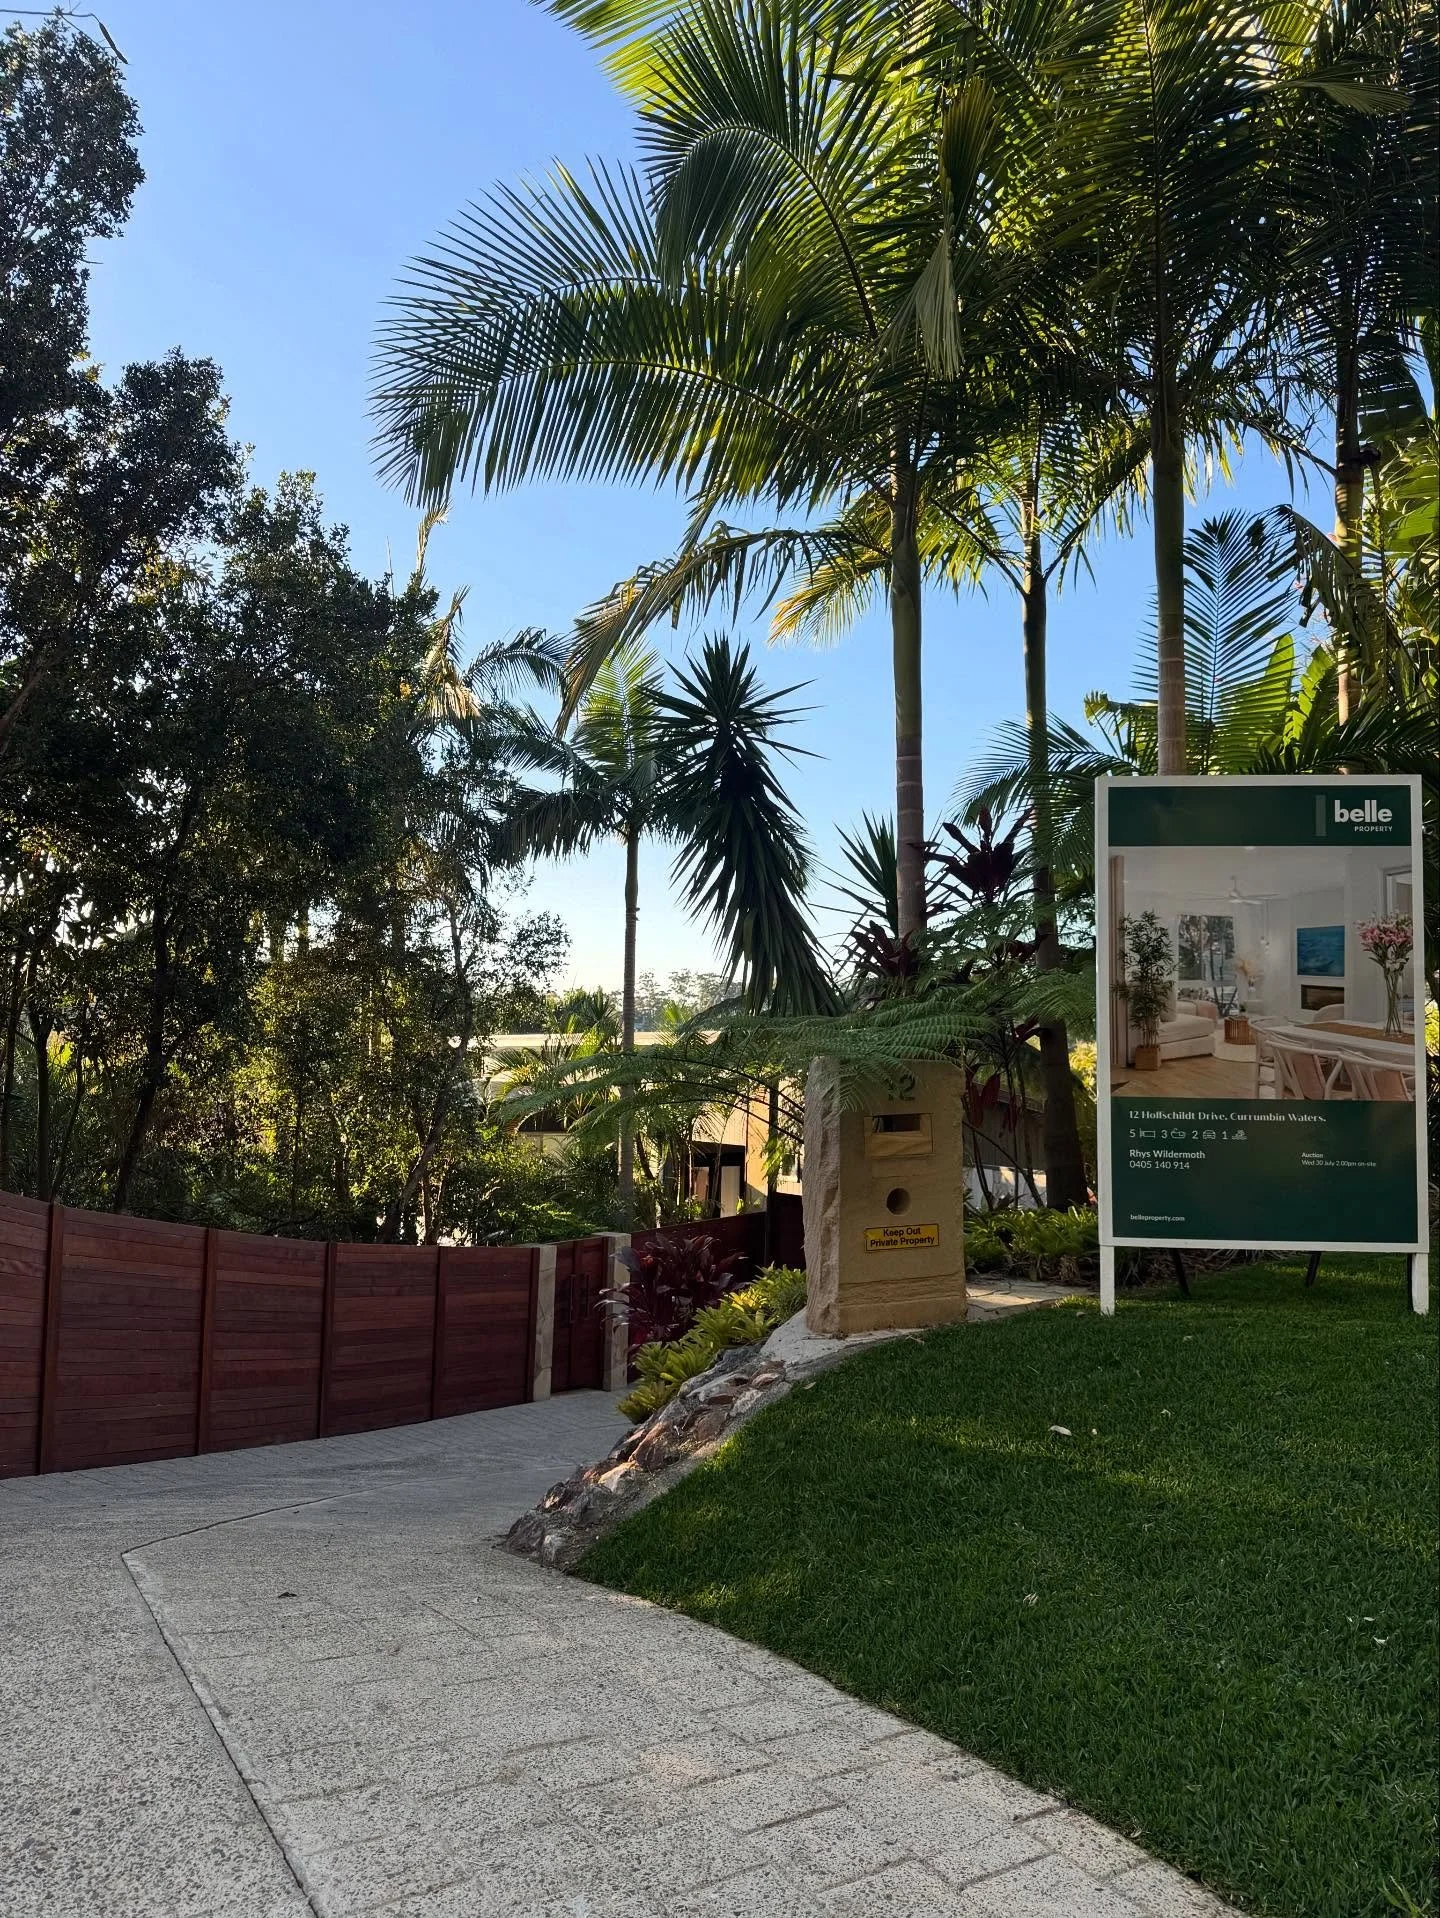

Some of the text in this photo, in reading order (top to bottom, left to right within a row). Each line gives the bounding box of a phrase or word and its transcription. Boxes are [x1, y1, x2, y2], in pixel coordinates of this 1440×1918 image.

[1334, 799, 1393, 823] belle
[1129, 1110, 1139, 1119] 12
[1229, 1112, 1285, 1121] Currumbin
[1287, 1113, 1327, 1122] Waters.
[1129, 1129, 1228, 1140] 5 3 2 1
[1129, 1149, 1206, 1159] Rhys Wildermoth
[1129, 1160, 1190, 1170] 0405 140 914
[1130, 1214, 1185, 1222] belleproperty.com
[883, 1227, 921, 1238] Keep Out
[870, 1236, 935, 1247] Private Property
